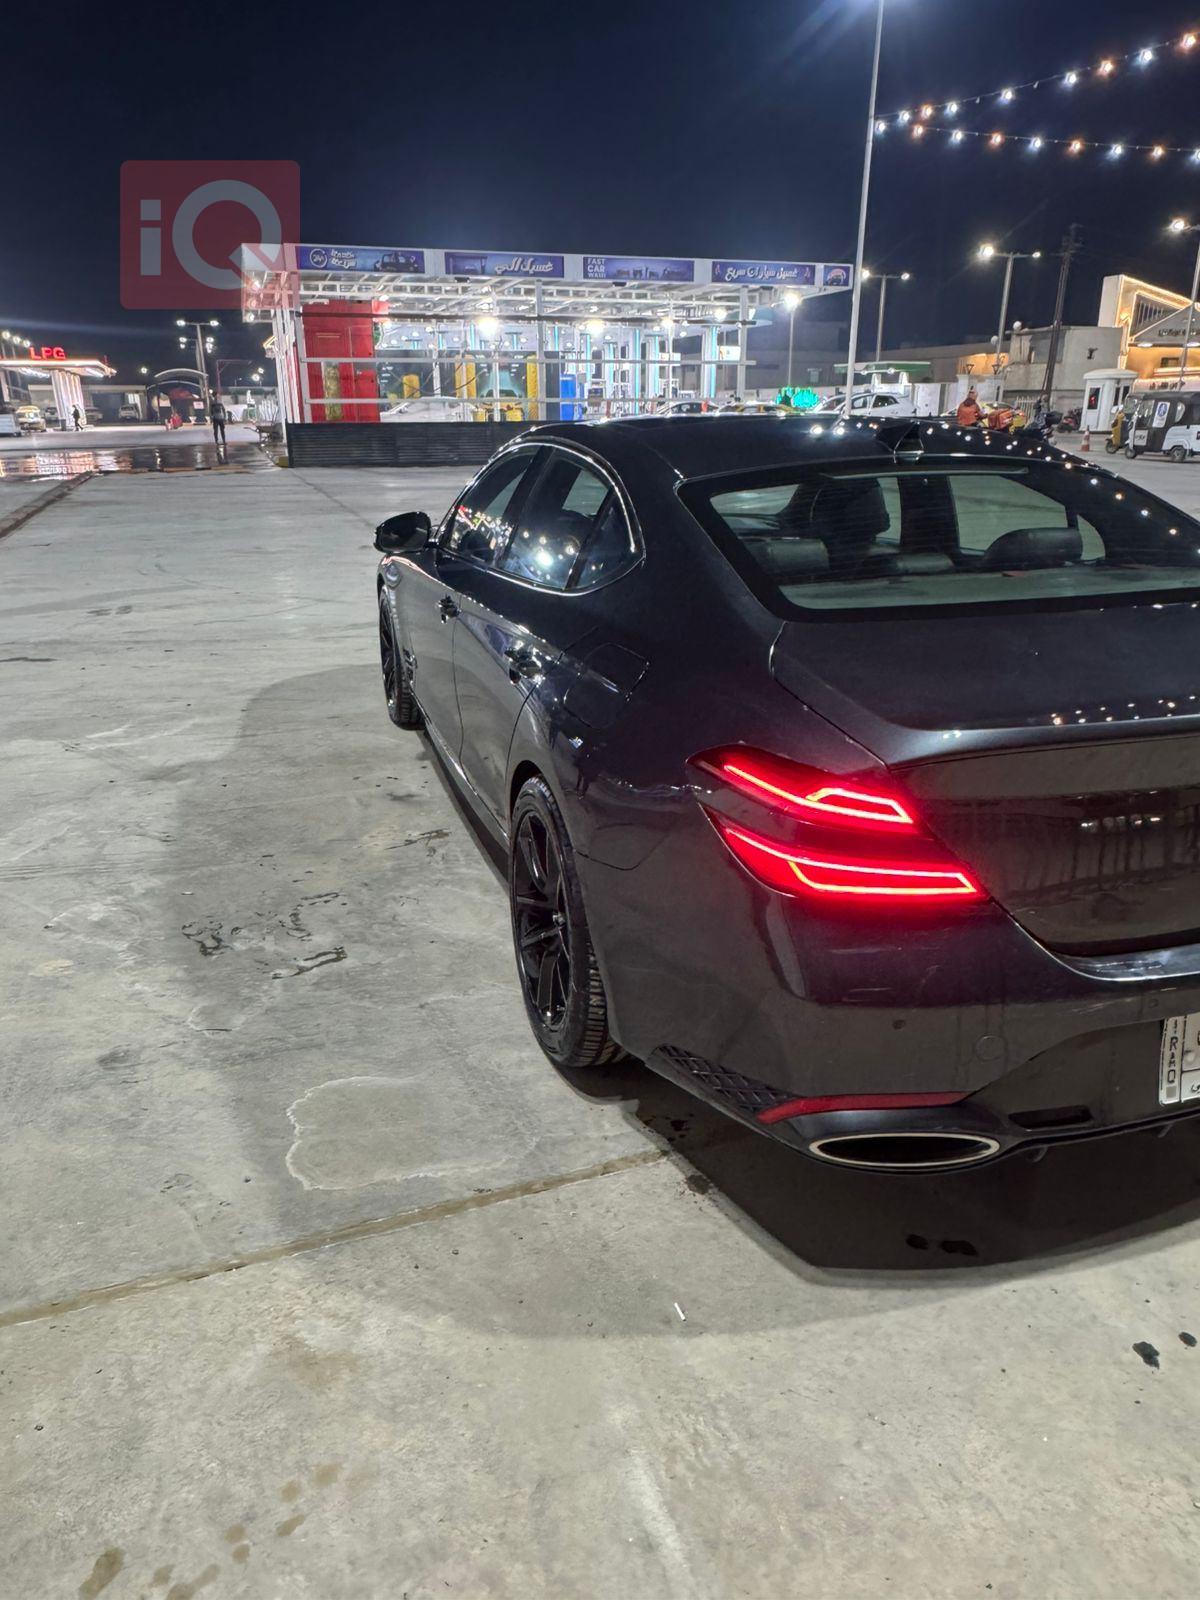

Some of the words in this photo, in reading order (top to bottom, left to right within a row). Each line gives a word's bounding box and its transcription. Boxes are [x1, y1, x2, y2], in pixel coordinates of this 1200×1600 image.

[520, 257, 554, 274] غسيل
[587, 257, 606, 265] FAST
[587, 264, 606, 273] CAR
[29, 347, 66, 360] LPG
